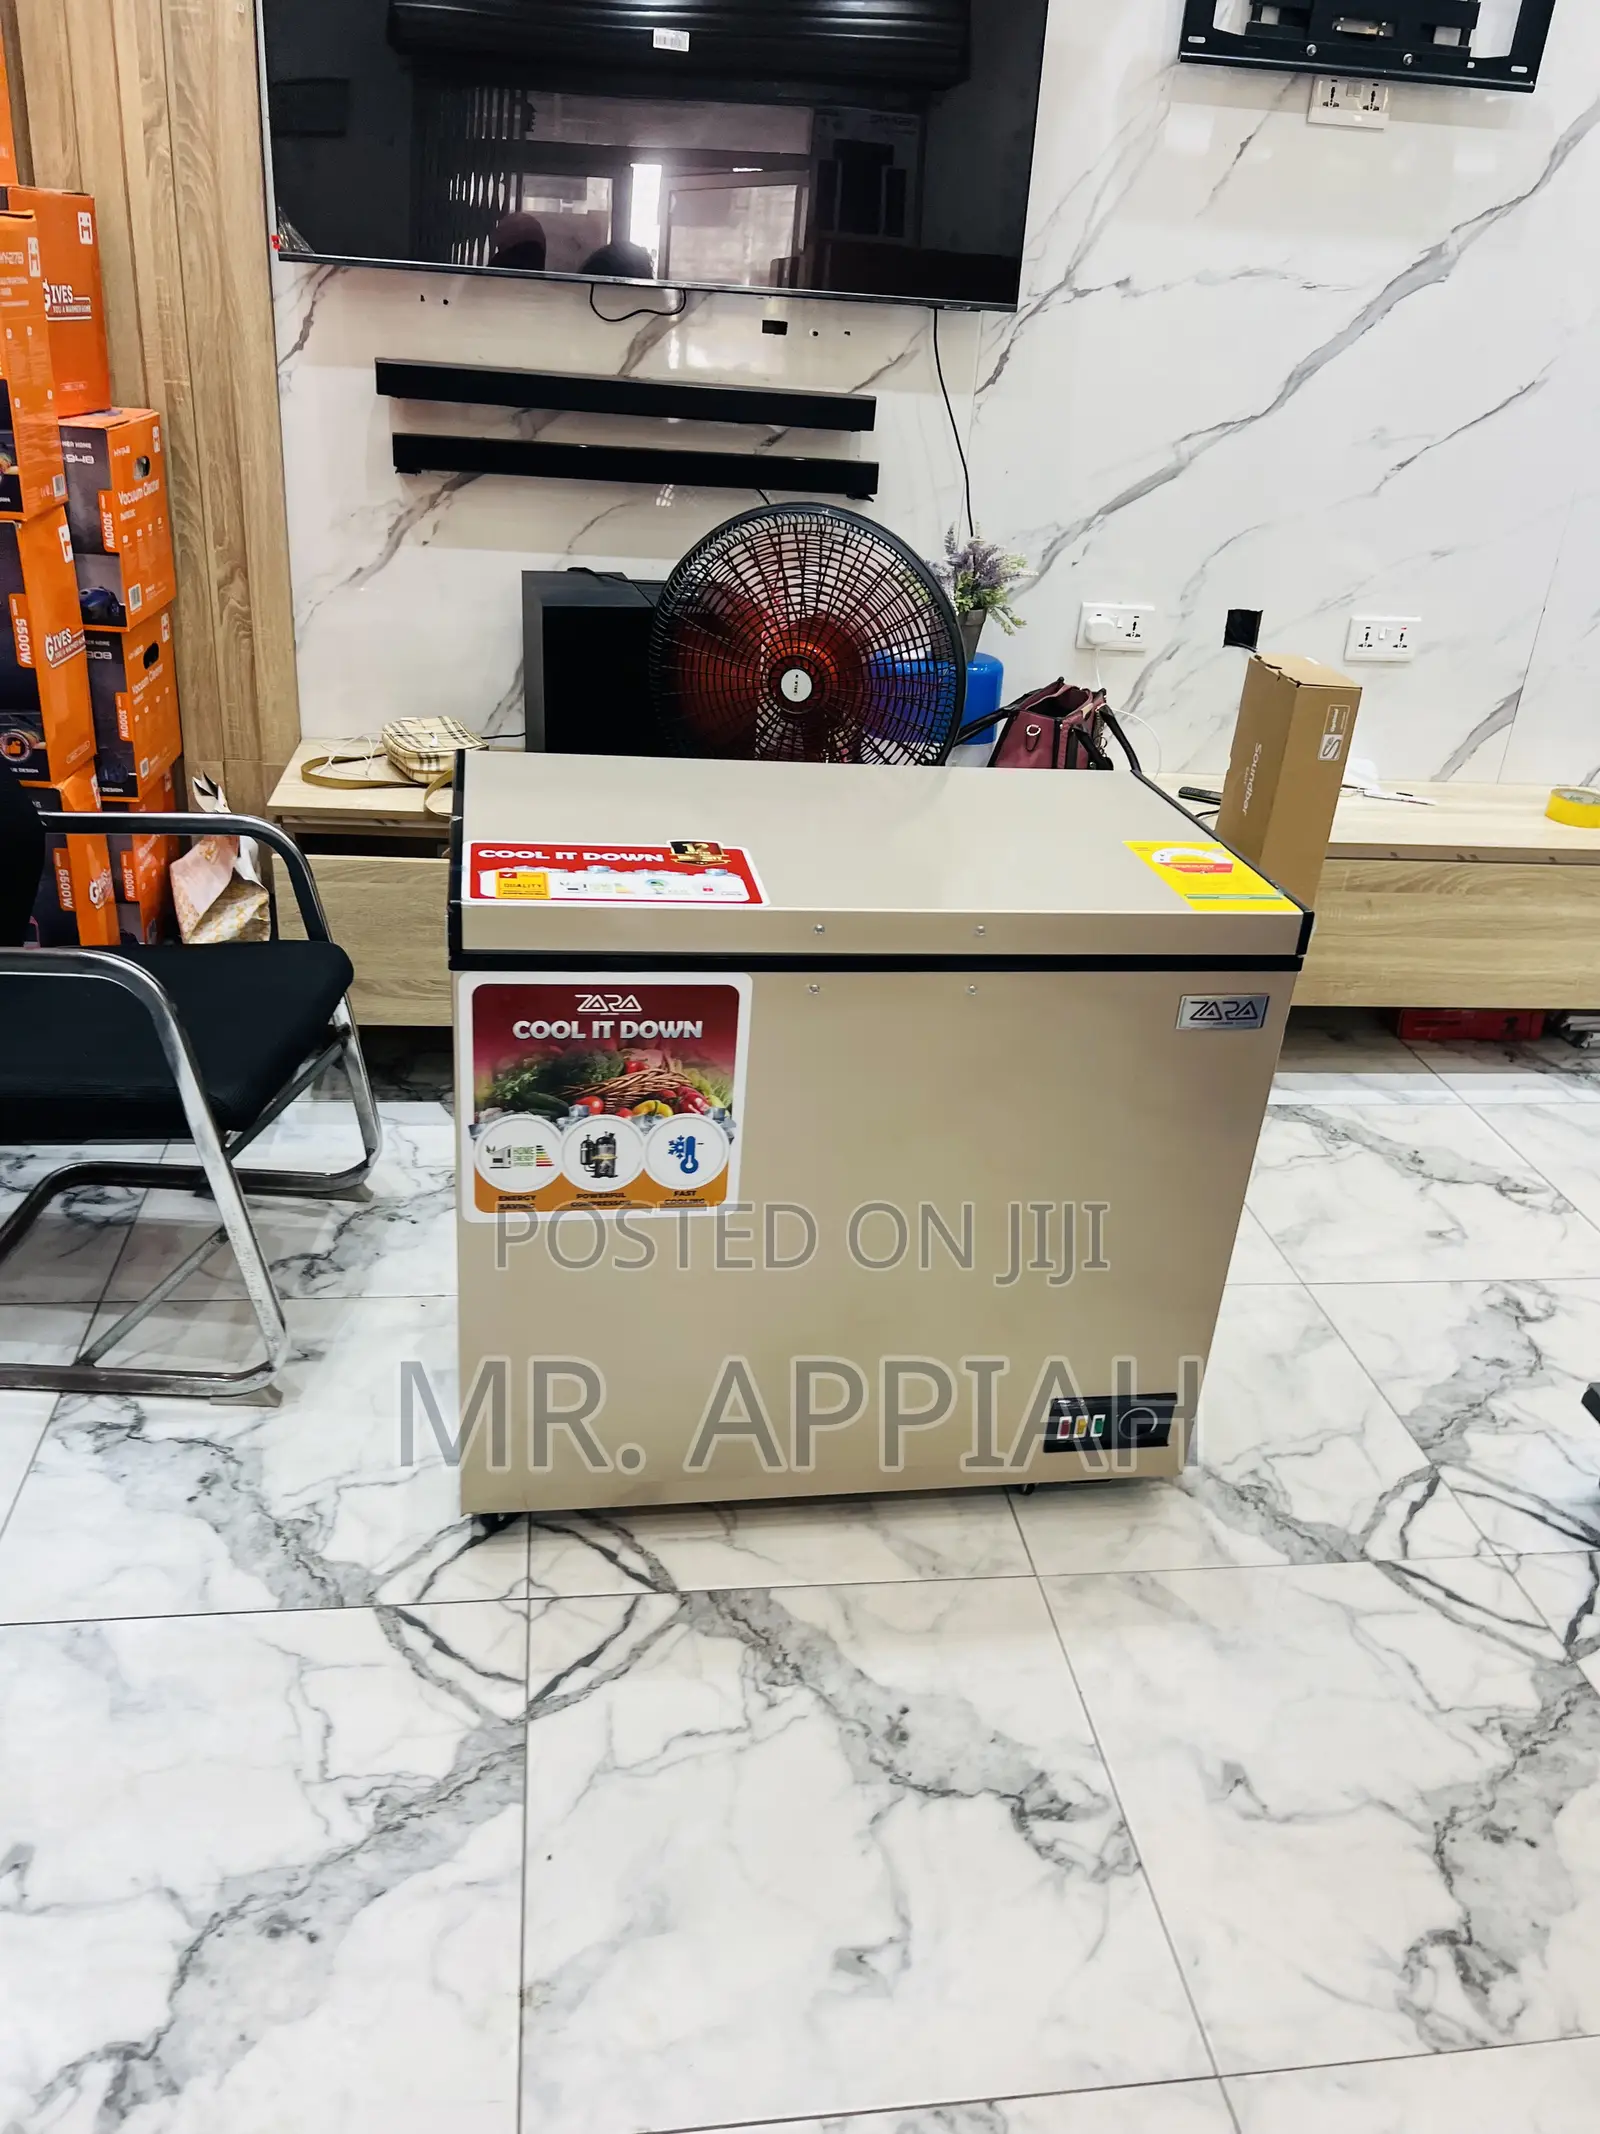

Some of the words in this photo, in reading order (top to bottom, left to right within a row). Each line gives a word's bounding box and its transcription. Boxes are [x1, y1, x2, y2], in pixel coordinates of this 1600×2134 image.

[118, 487, 143, 505] Vacuum
[102, 512, 115, 549] 3000W
[15, 618, 32, 665] 5500W
[45, 627, 72, 662] GIVES
[118, 709, 129, 738] 3000W
[1242, 743, 1262, 816] Soundbar
[478, 850, 550, 860] COOL
[555, 852, 578, 860] IT
[583, 853, 664, 862] DOWN
[574, 994, 642, 1013] ZARA
[1189, 1001, 1258, 1020] ZARA
[512, 1020, 587, 1040] COOL
[592, 1021, 615, 1039] IT
[619, 1020, 703, 1039] DOWN
